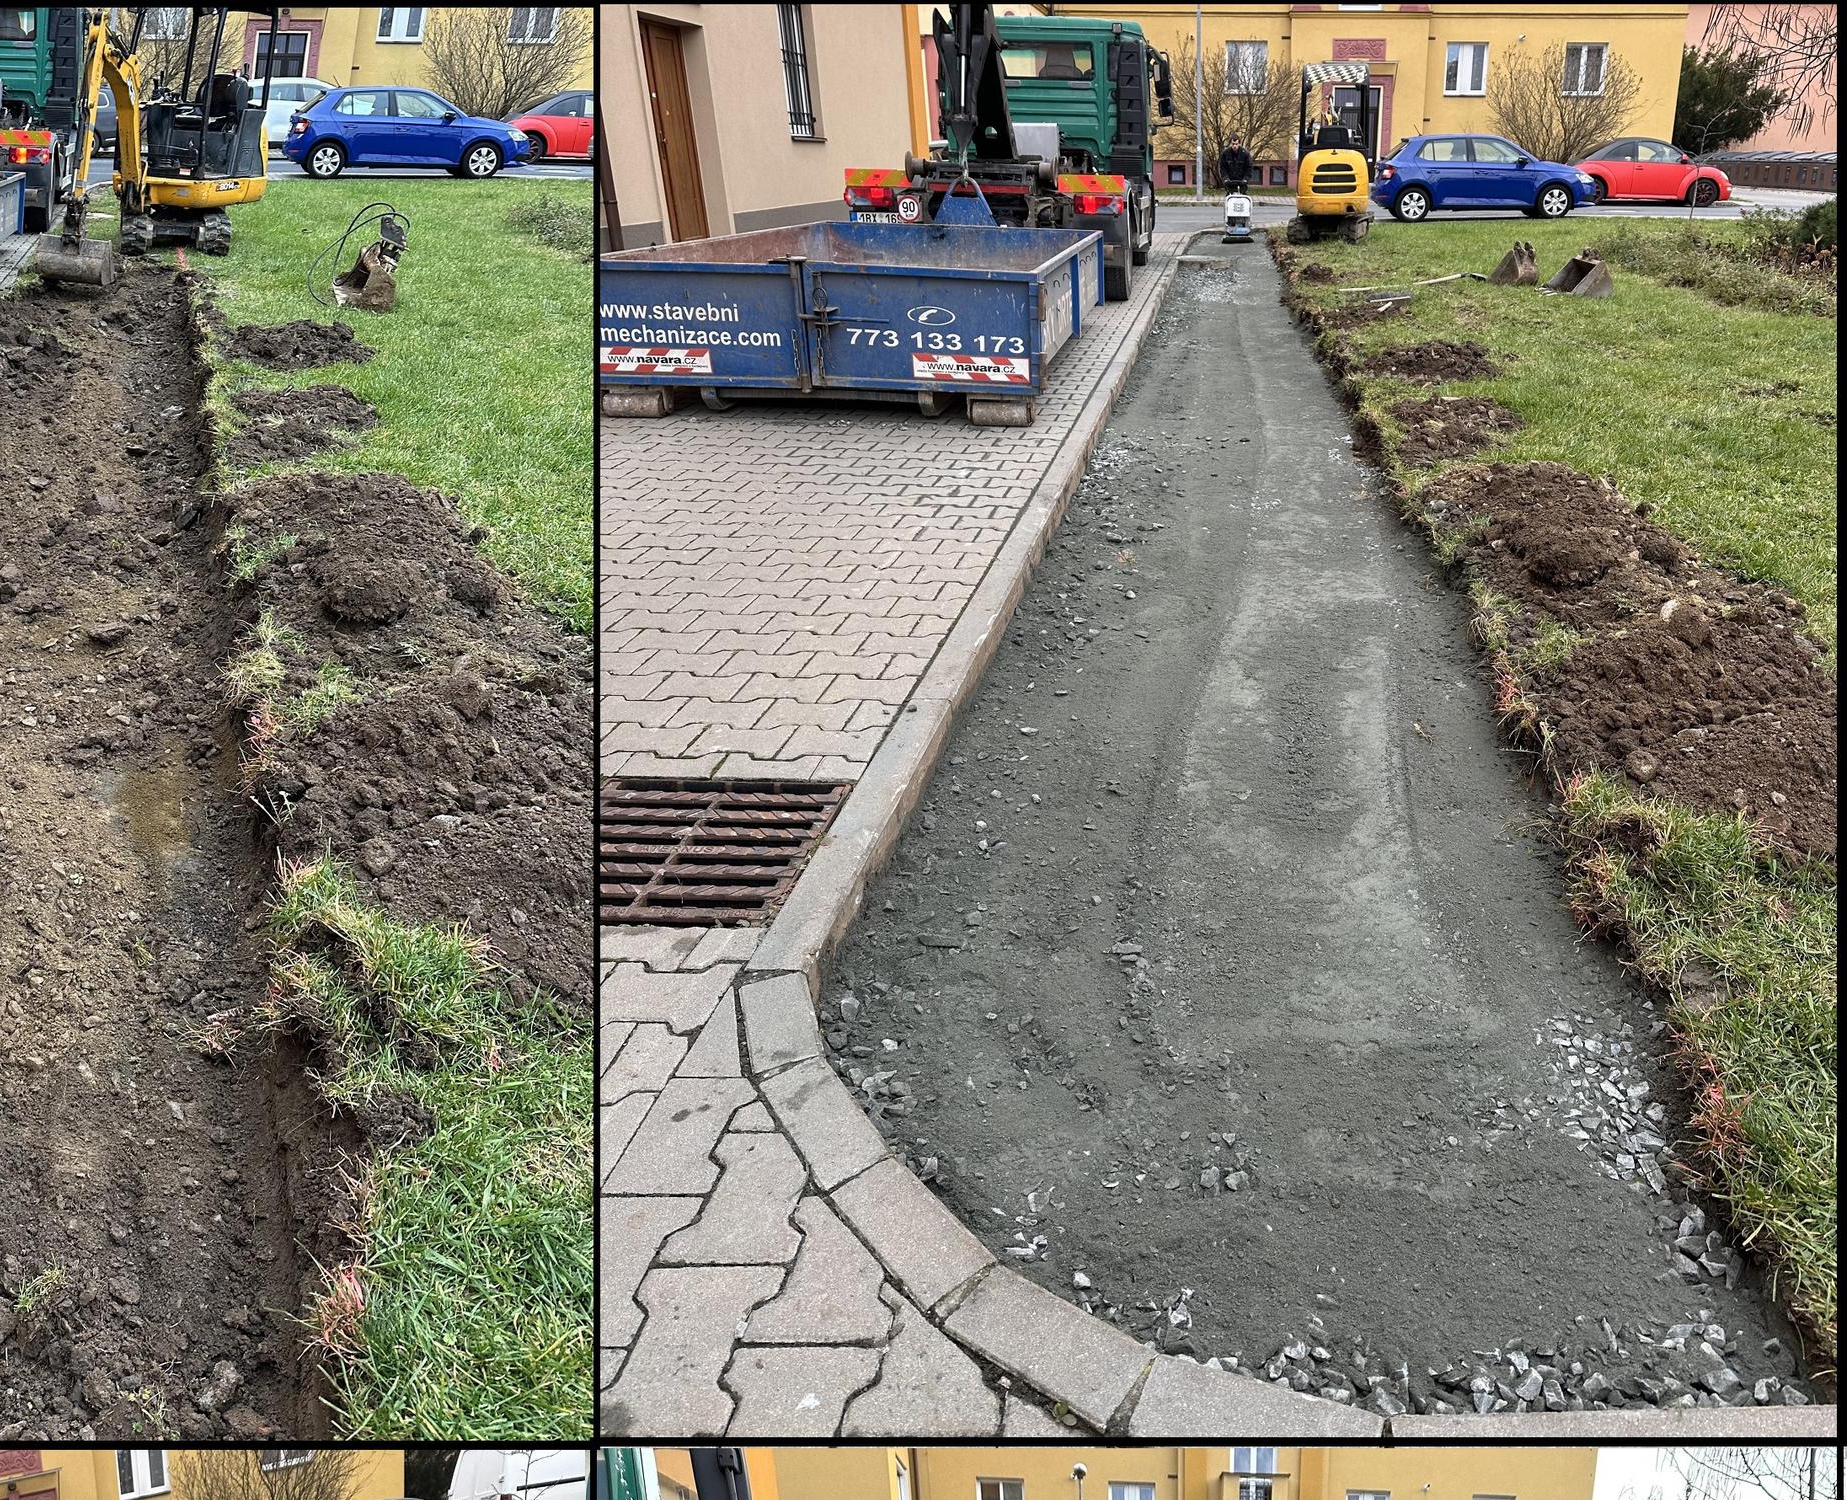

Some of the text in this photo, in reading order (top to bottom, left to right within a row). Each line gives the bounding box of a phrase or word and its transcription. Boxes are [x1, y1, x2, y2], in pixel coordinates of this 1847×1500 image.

[901, 201, 916, 213] 90
[600, 324, 782, 347] mechanizace.com
[846, 328, 1026, 354] 773 133 173
[607, 355, 698, 366] www.navara.cz
[926, 362, 1016, 374] www.navara.cz
